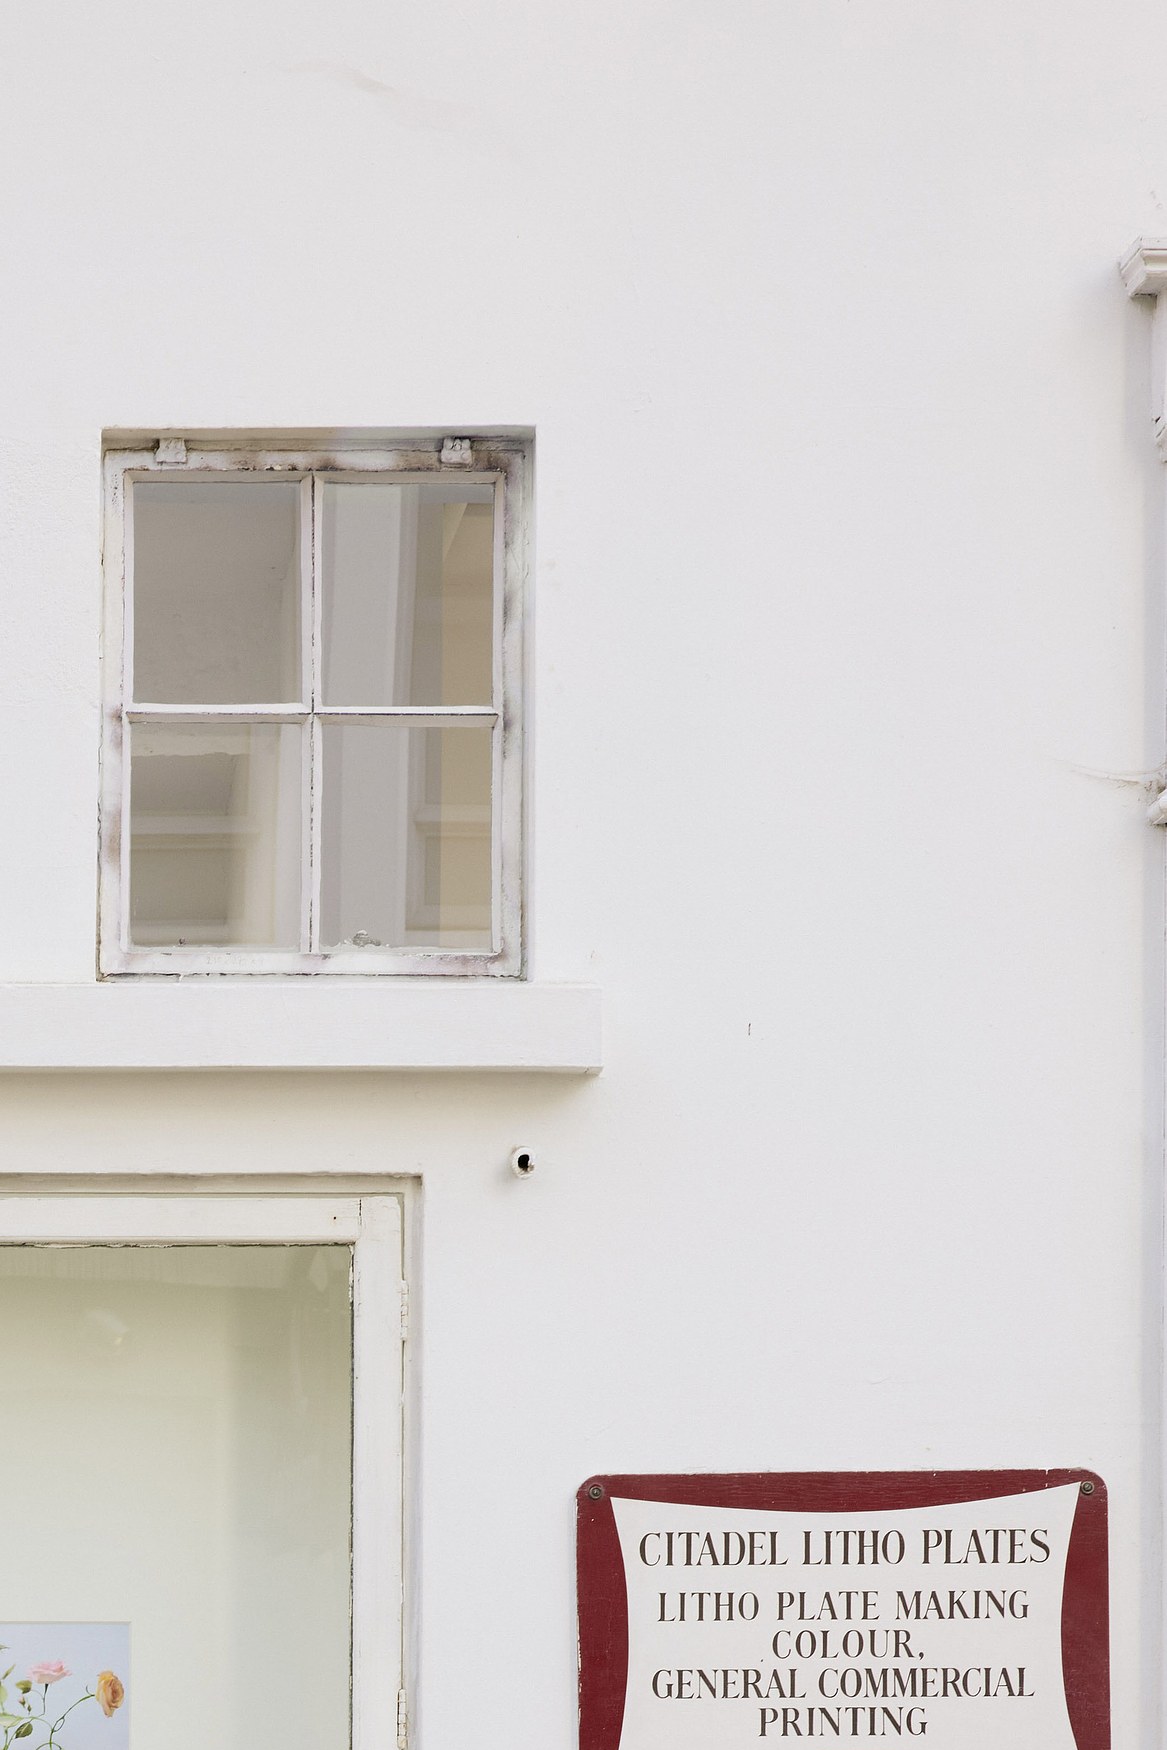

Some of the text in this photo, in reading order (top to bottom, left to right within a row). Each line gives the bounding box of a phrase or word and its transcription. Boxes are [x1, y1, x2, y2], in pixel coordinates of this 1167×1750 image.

[639, 1528, 1051, 1567] CITADEL LITHO PLATES
[657, 1589, 1029, 1622] LITHO PLATE MAKING
[772, 1629, 925, 1661] COLOUR,
[651, 1667, 1035, 1700] GENERAL COMMERCIAL
[758, 1706, 928, 1737] PRINTING
